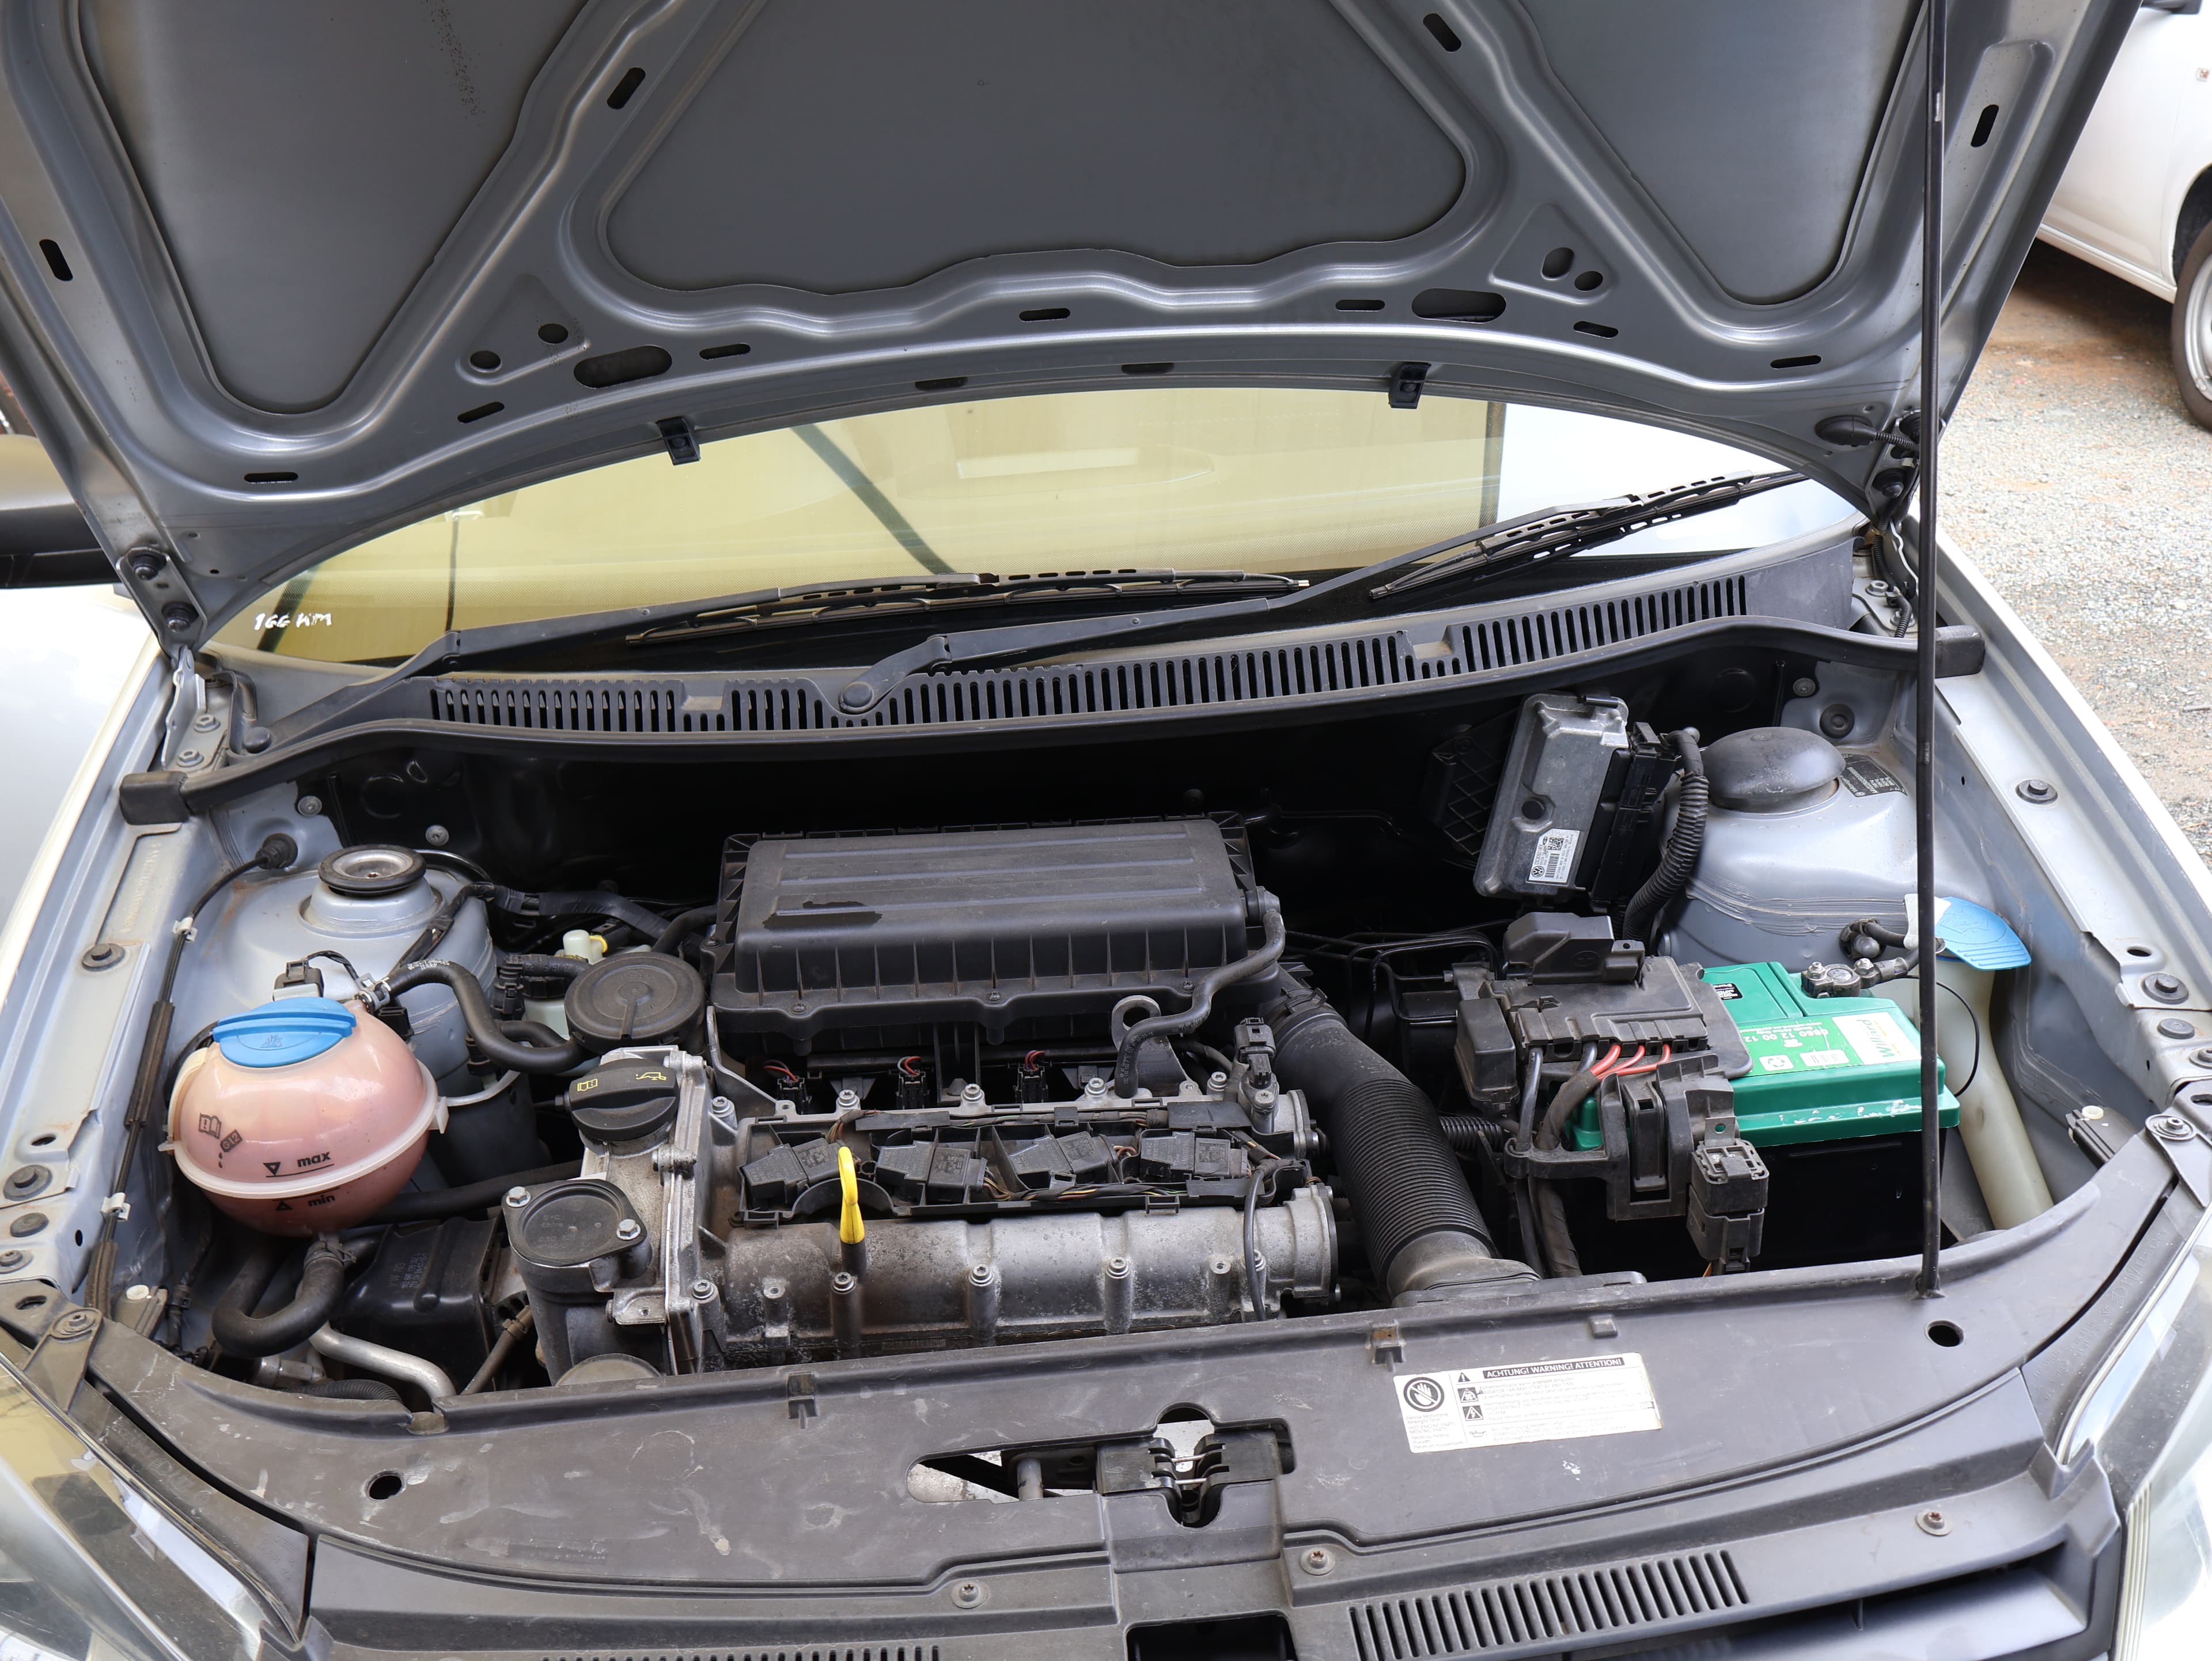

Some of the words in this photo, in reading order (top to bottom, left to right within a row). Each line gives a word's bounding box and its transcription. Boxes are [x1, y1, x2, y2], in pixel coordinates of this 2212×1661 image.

[1855, 1019, 1896, 1058] Willard
[297, 1152, 331, 1168] max
[308, 1194, 336, 1208] min
[1486, 1368, 1531, 1379] ACHTUNG!
[1531, 1363, 1574, 1374] WARNING!
[1575, 1357, 1623, 1369] ATTENTION!
